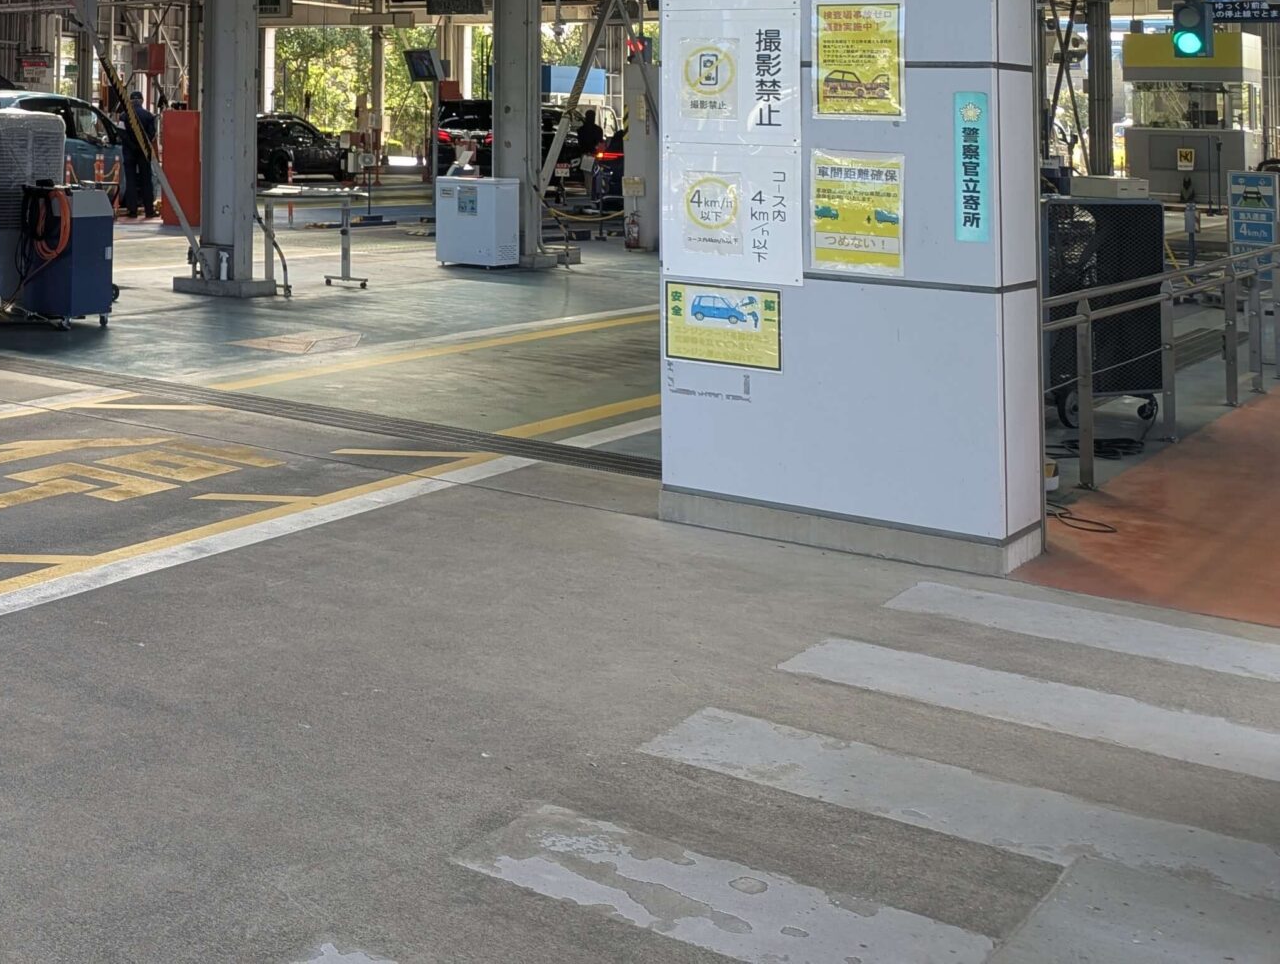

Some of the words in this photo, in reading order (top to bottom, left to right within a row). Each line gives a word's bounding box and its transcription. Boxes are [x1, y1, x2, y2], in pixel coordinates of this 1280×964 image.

[755, 29, 782, 127] 撮影禁止
[772, 171, 786, 222] コース内
[817, 166, 898, 182] 車間距離確保
[962, 127, 980, 228] 警察官立寄所
[700, 211, 722, 222] 以下
